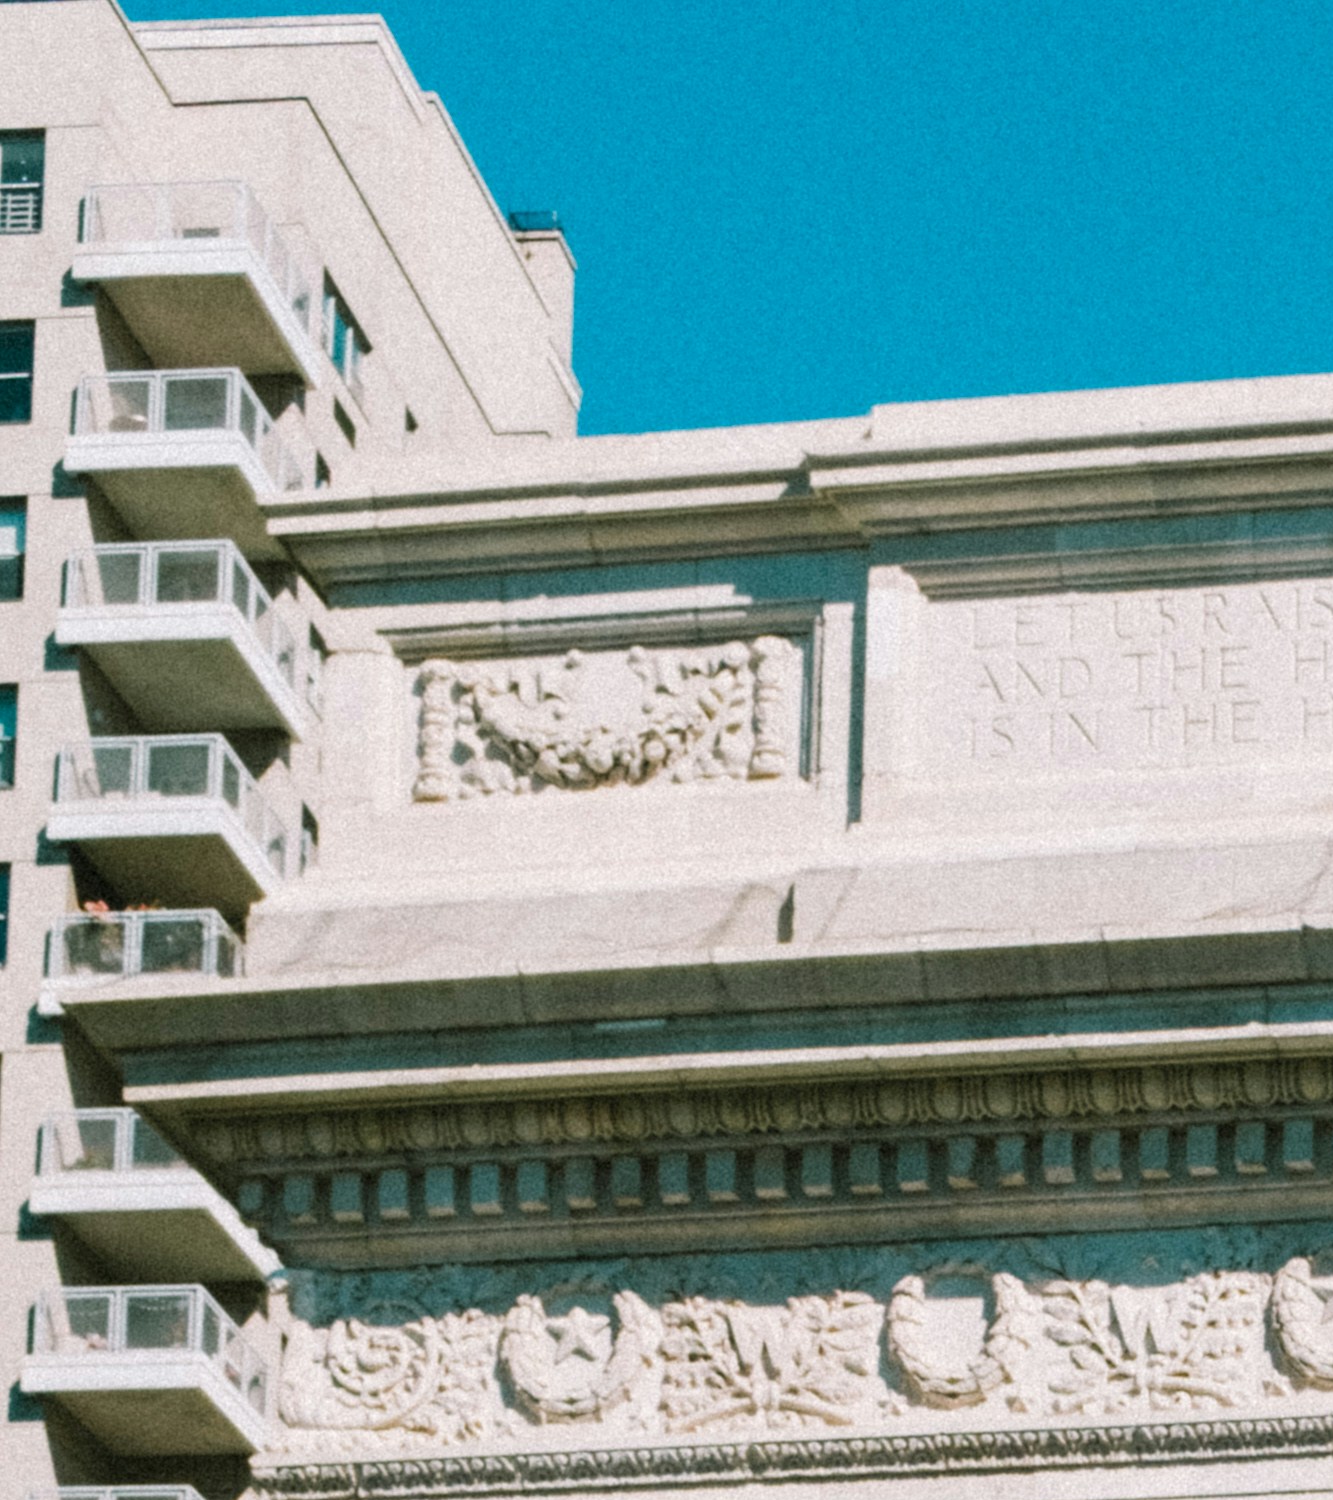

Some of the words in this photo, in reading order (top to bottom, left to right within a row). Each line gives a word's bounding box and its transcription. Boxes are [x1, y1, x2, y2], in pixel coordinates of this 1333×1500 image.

[972, 601, 1084, 650] LET
[1112, 595, 1178, 641] US
[974, 655, 1093, 704] AND
[1120, 644, 1250, 695] THE
[969, 717, 1014, 759] IS
[1050, 708, 1101, 757] IN
[1132, 699, 1261, 746] THE
